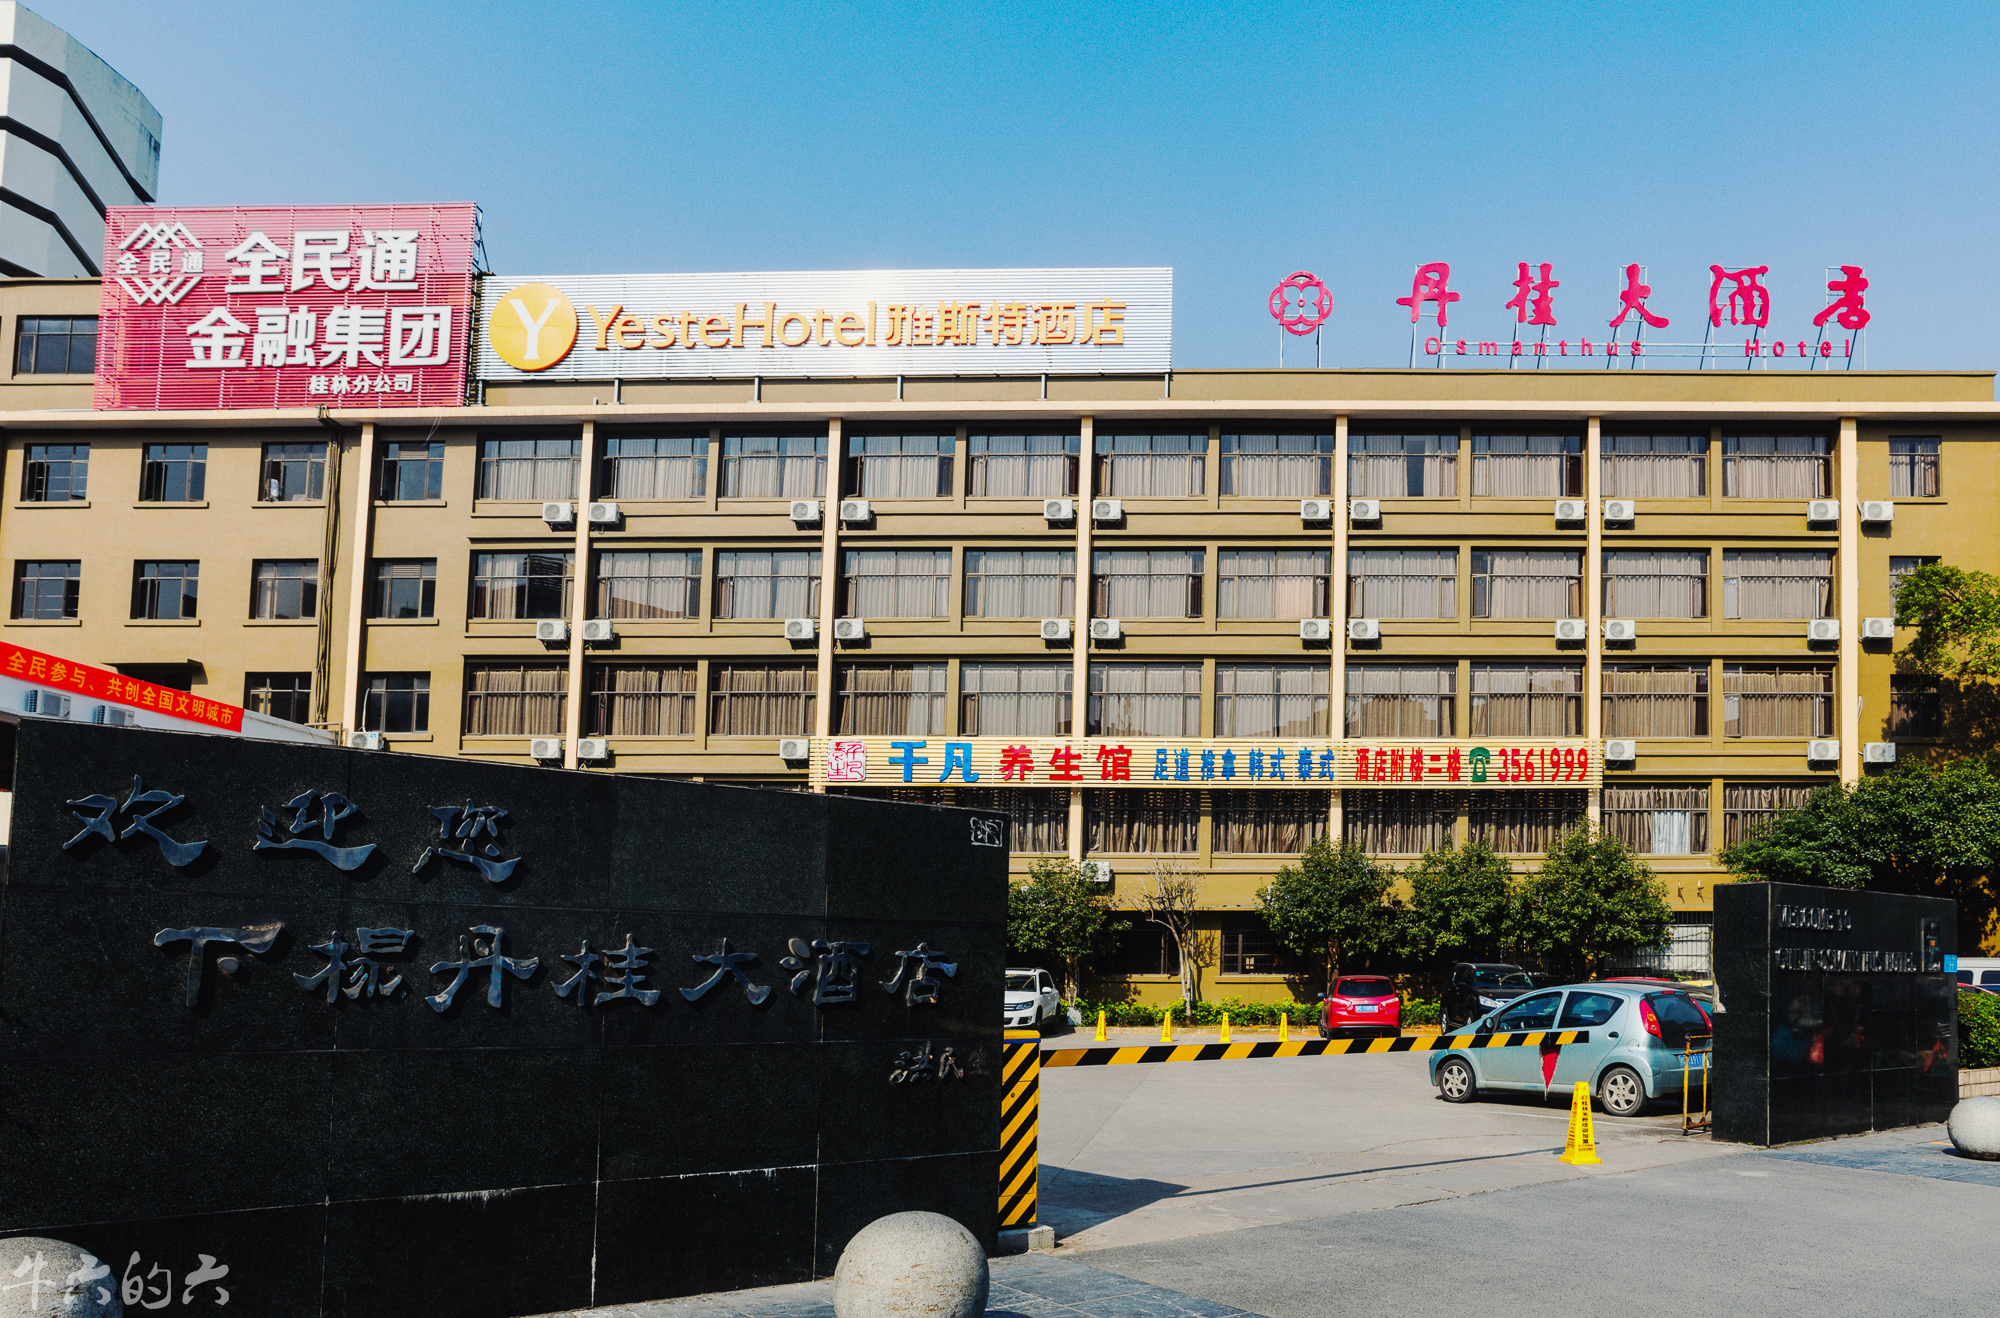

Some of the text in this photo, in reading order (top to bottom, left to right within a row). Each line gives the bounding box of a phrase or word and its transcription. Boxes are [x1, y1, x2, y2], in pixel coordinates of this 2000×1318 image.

[116, 250, 205, 276] 全民通
[224, 229, 419, 295] 全民通
[1396, 261, 1872, 330] 丹桂大酒店
[185, 305, 453, 370] 金融集团
[585, 298, 1128, 350] YesteHotel 雅斯特酒店
[1424, 336, 1851, 358] Osmanthus Hotel
[309, 373, 414, 396] 桂林分公司
[888, 740, 980, 783] 千凡
[999, 744, 1133, 782] 养生馆
[1355, 746, 1462, 783] 酒店附楼二楼
[1497, 747, 1589, 783] 3561999
[63, 774, 522, 883] 欢迎您
